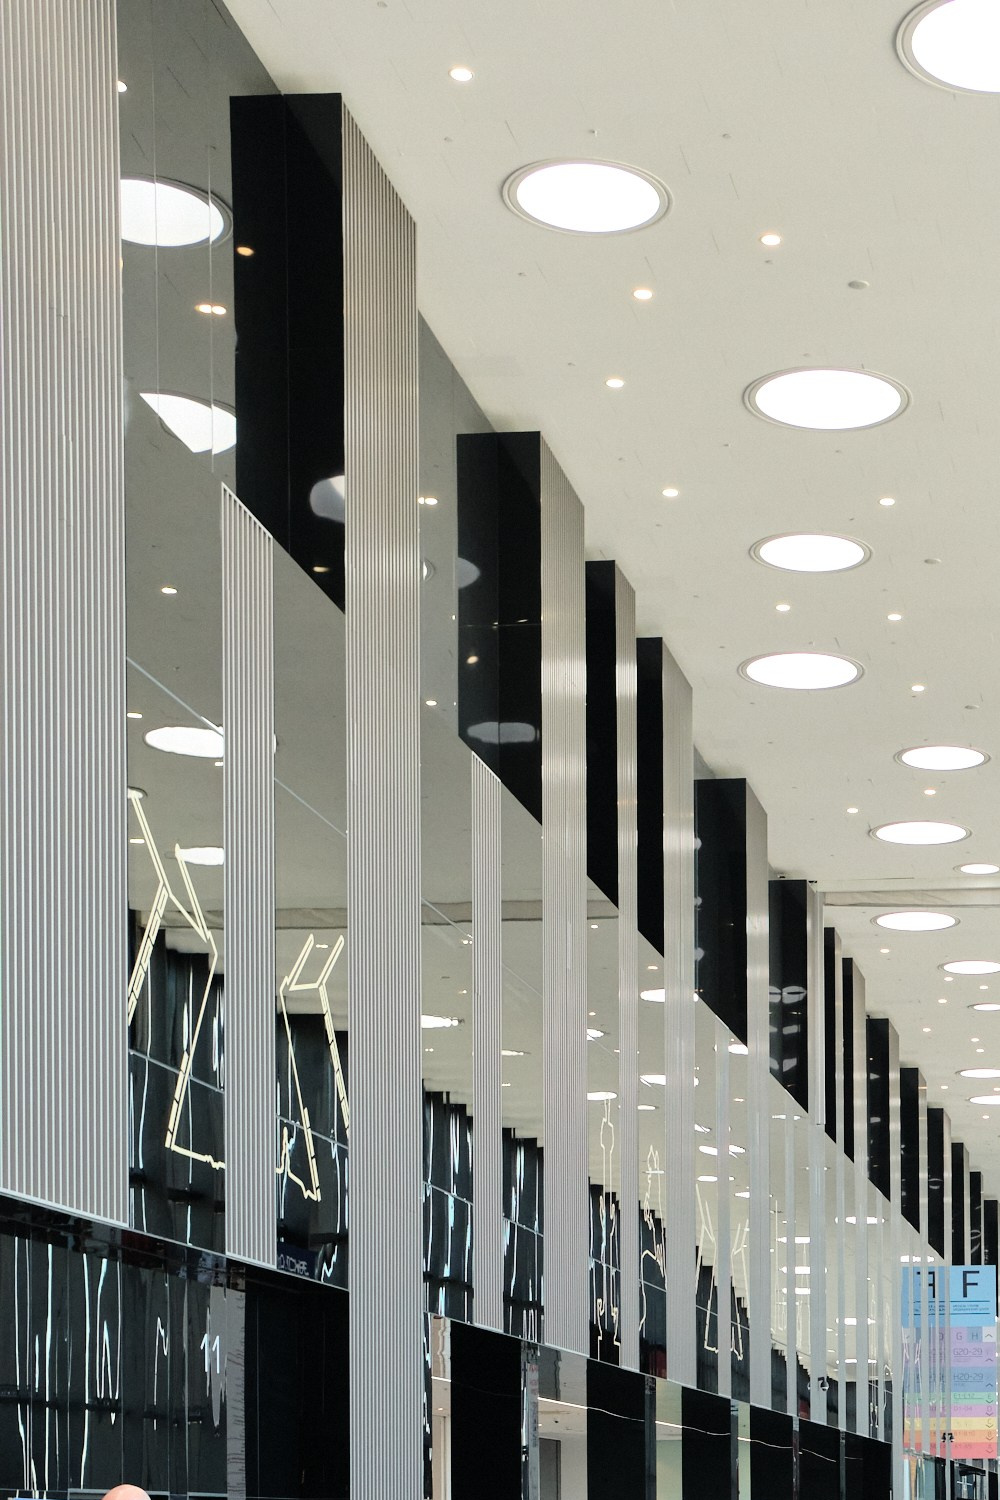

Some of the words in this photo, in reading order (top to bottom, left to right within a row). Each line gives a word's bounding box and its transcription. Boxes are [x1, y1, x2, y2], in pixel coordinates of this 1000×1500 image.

[963, 1270, 980, 1298] F
[956, 1332, 963, 1341] G
[971, 1332, 978, 1341] H
[200, 1334, 220, 1374] 11
